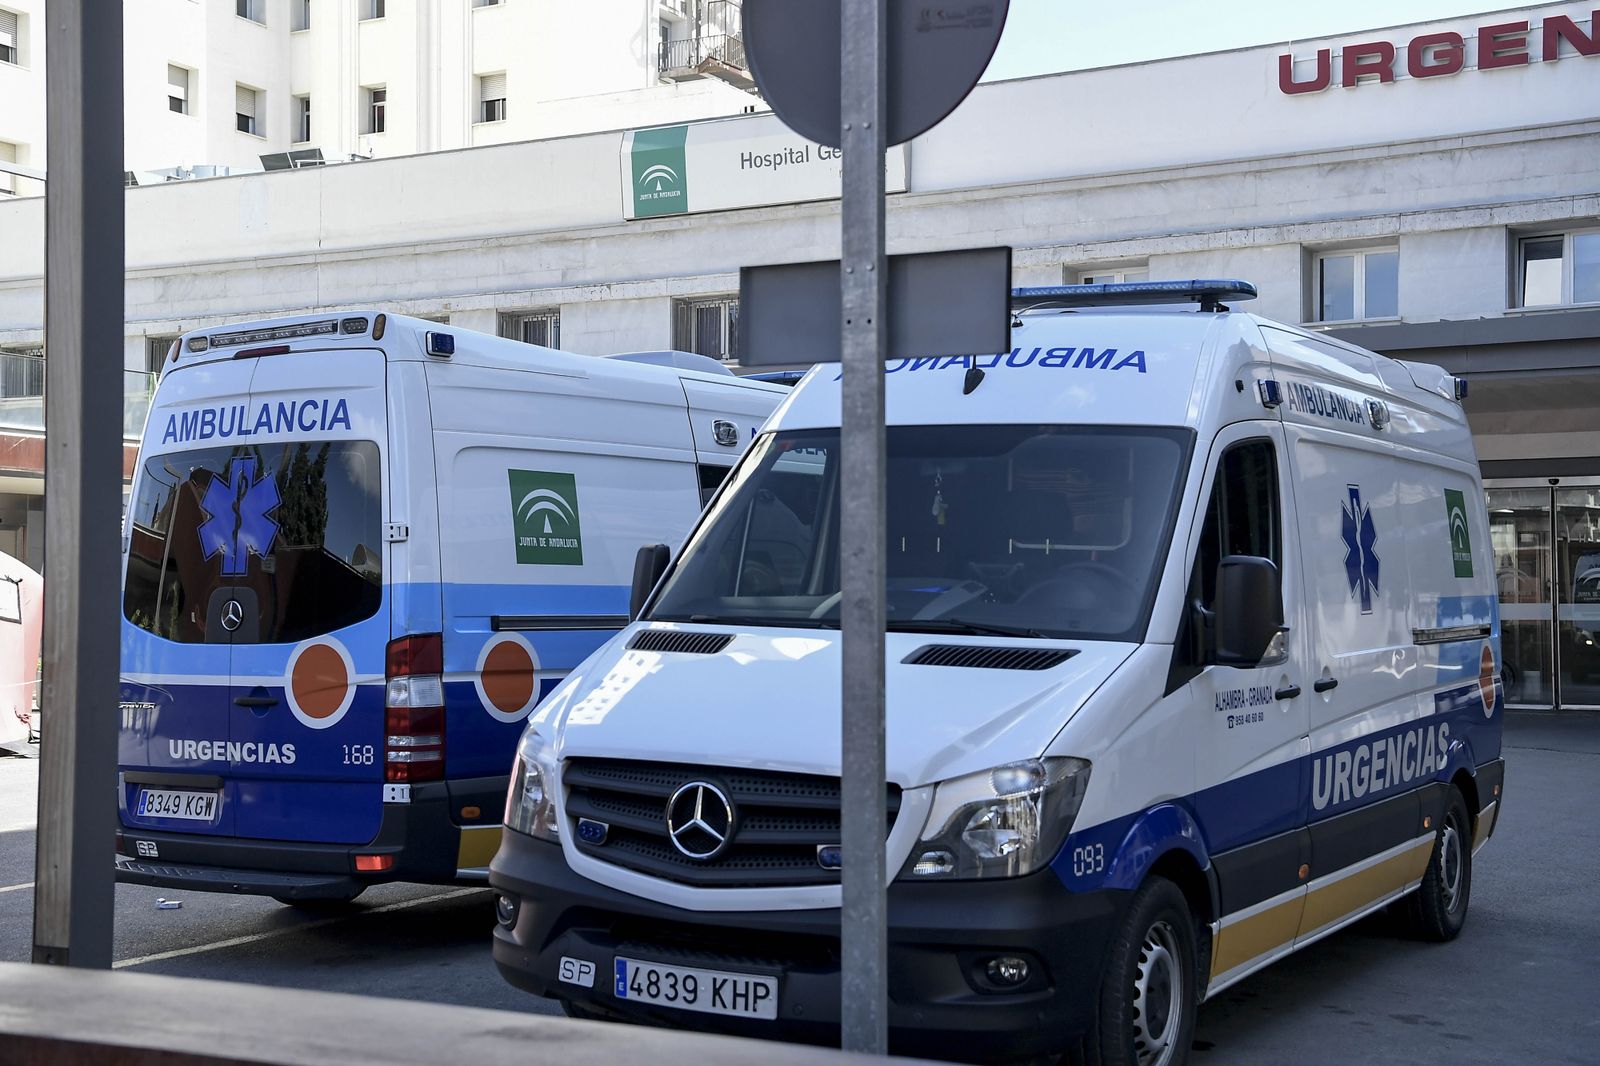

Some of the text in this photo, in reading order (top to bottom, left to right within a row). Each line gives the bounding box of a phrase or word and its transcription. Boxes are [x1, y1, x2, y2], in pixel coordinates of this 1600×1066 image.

[740, 145, 809, 170] Hospital
[1286, 381, 1366, 425] AMBULANCIA
[162, 399, 351, 444] AMBULANCIA
[519, 536, 578, 548] JUNTA DE ANDALUCIA
[1215, 689, 1245, 712] ALHAMBRA
[1248, 685, 1273, 707] GRANADA
[169, 739, 296, 764] URGENCIAS
[342, 745, 374, 765] 168
[1313, 722, 1450, 810] URGENCIAS
[147, 794, 215, 817] 8349 KGW
[138, 842, 155, 855] SP
[1074, 843, 1104, 877] 093
[562, 960, 592, 982] SP
[629, 966, 771, 1013] 4839 KHP
